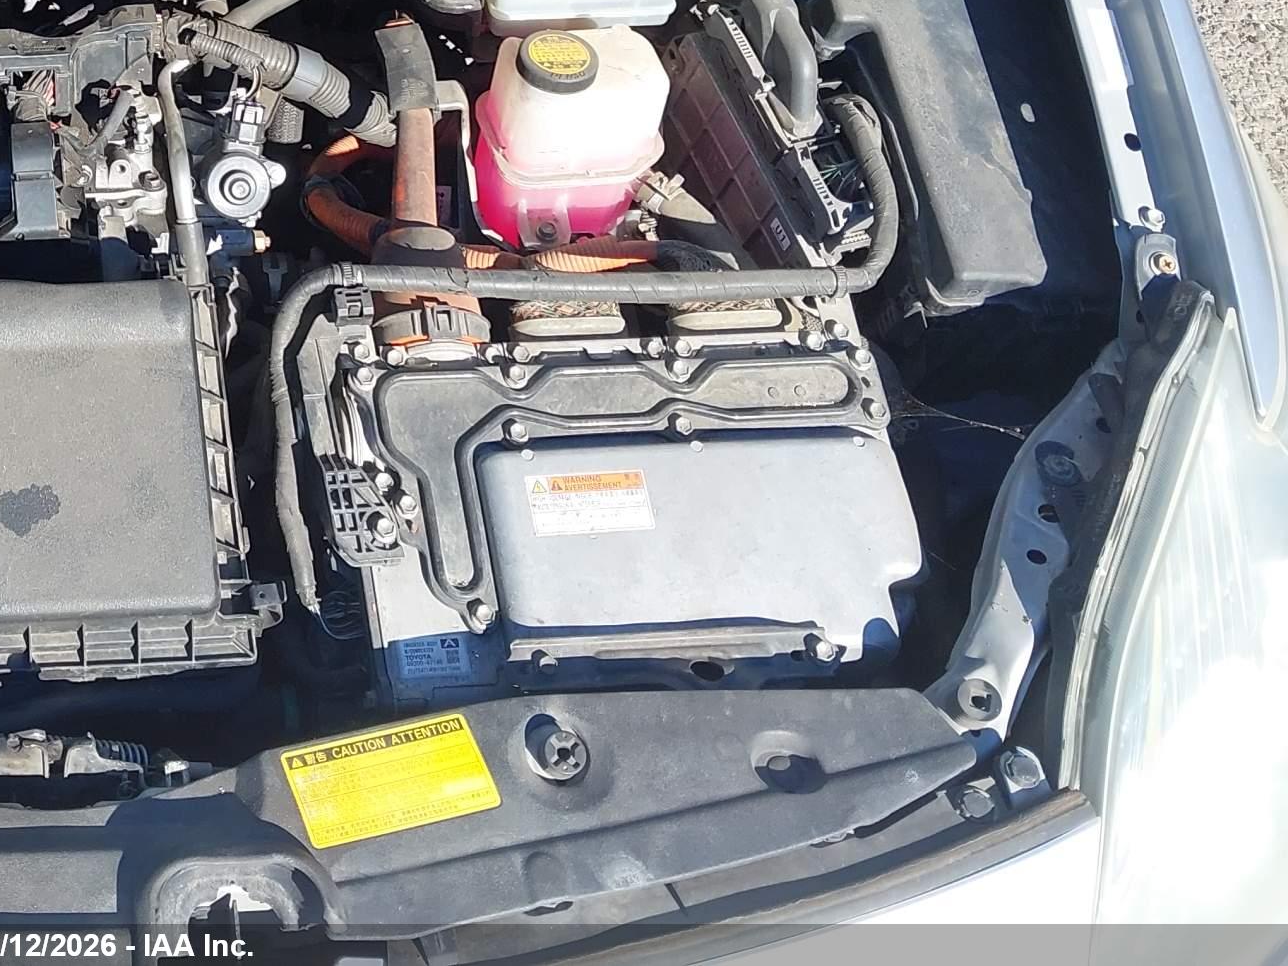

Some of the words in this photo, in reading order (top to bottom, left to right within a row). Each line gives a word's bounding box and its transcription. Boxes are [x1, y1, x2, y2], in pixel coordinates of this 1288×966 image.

[562, 474, 602, 484] WARNING
[564, 481, 622, 491] AVERTISSEMENT
[331, 737, 386, 758] CAUTION
[391, 719, 461, 746] ATTENTION
